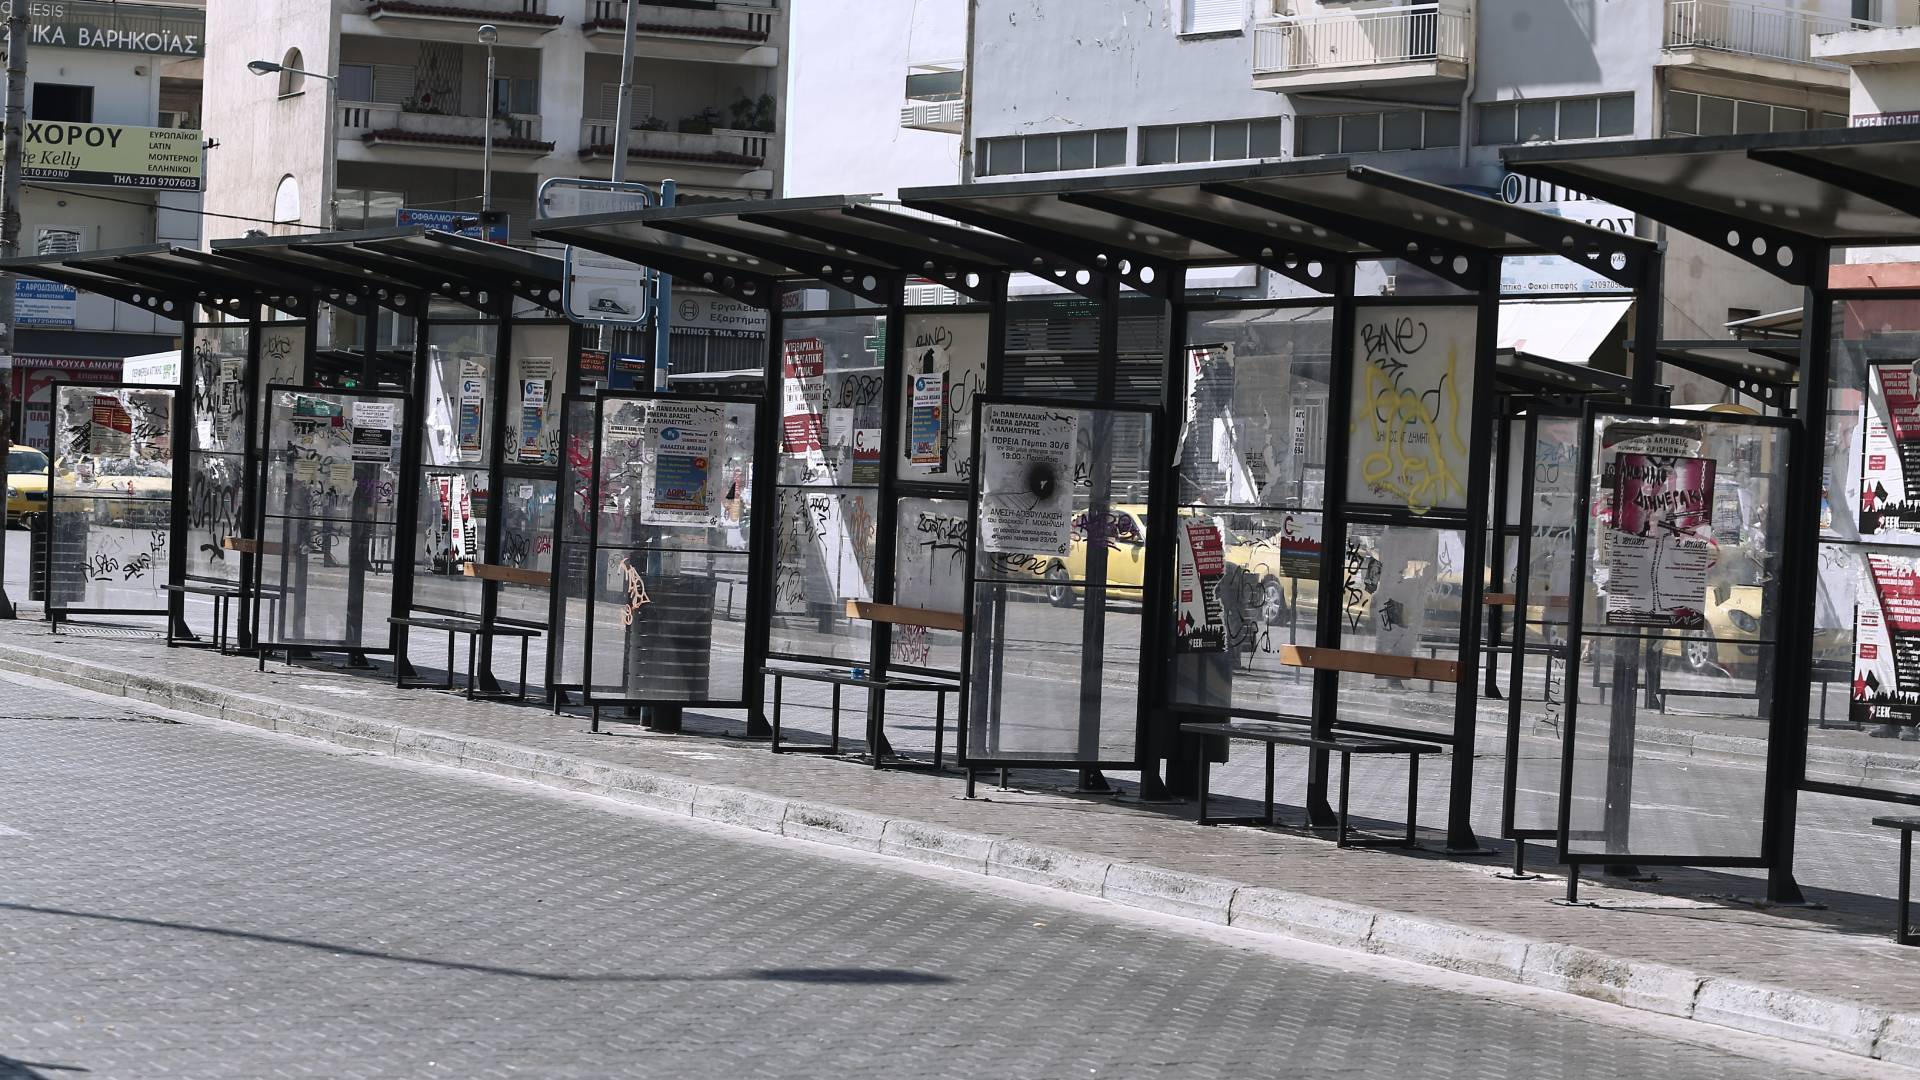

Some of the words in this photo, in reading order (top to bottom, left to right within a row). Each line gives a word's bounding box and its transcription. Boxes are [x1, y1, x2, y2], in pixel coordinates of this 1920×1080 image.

[78, 27, 198, 54] ΒΑΡΗΚΟΪΑΣ
[26, 122, 123, 148] ΧΟΡΟΥ
[149, 142, 171, 150] LATIN
[40, 150, 81, 169] Kelly
[148, 153, 198, 163] ΜΟΝΤΕΡΝΟΙ
[148, 164, 191, 174] ΕΛΛΗΝΙΚΟΙ
[139, 177, 155, 186] 210
[157, 177, 196, 188] 9707603
[56, 359, 86, 369] ΡΟΥΧΑ
[1000, 411, 1047, 421] ΠΑΝΕΛΛΑΔΙΚΗ
[1014, 420, 1039, 428] ΔΡΑΣΗΣ
[996, 426, 1041, 435] ΑΛΛΗΛΕΓΓΥΗΣ
[992, 436, 1019, 446] ΠΟΡΕΙΑ
[1049, 441, 1069, 450] 30/6
